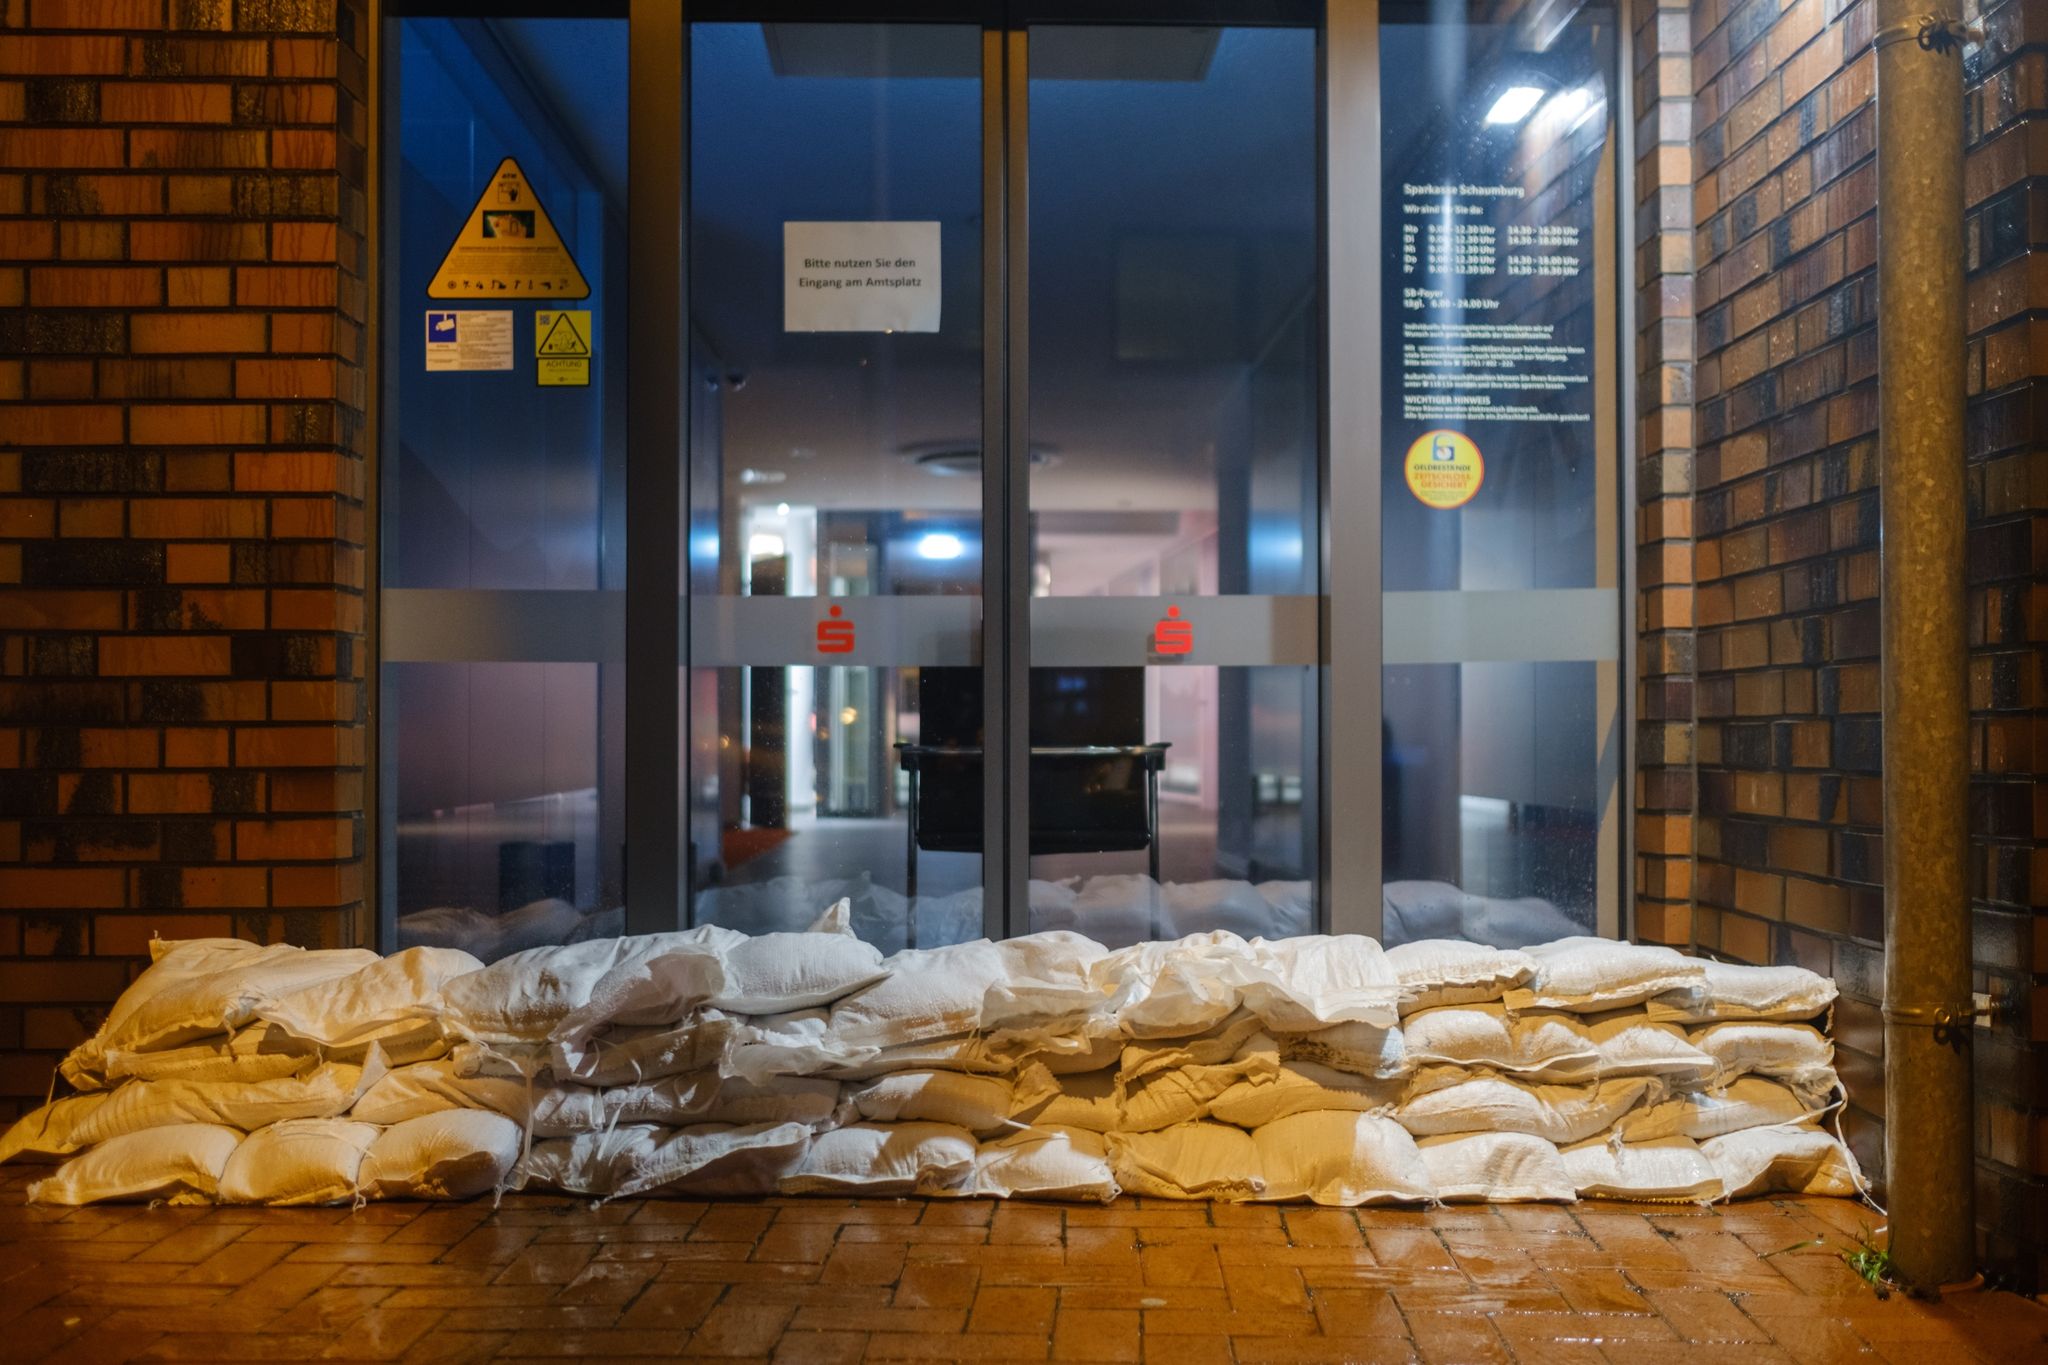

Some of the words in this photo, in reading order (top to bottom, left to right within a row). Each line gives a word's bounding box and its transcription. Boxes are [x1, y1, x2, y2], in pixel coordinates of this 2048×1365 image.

[1403, 183, 1458, 197] Sparkasse
[1459, 184, 1525, 198] Schaumburg
[1428, 224, 1448, 234] 9.0
[1480, 225, 1496, 235] Uhr
[1563, 226, 1579, 236] Uhr
[1480, 235, 1496, 244] Uhr
[1563, 236, 1579, 246] Uhr
[1480, 245, 1496, 255] Uhr
[805, 258, 831, 268] Bitte
[834, 259, 872, 268] nutzen
[875, 258, 891, 268] Sie
[894, 258, 915, 268] den
[1480, 255, 1496, 265] Uhr
[1563, 256, 1579, 266] Uhr
[1480, 265, 1496, 275] Uhr
[1563, 267, 1579, 276] Uhr
[799, 277, 842, 289] Eingang
[846, 279, 862, 287] am
[866, 277, 922, 289] Amtsplatz
[1403, 287, 1443, 299] SB-Foyer
[1457, 299, 1481, 309] 24.00
[1483, 299, 1500, 309] Uhr
[546, 360, 582, 368] ACHTUNG
[1404, 395, 1453, 404] WICHTIGER
[1454, 395, 1491, 405] HINWEIS
